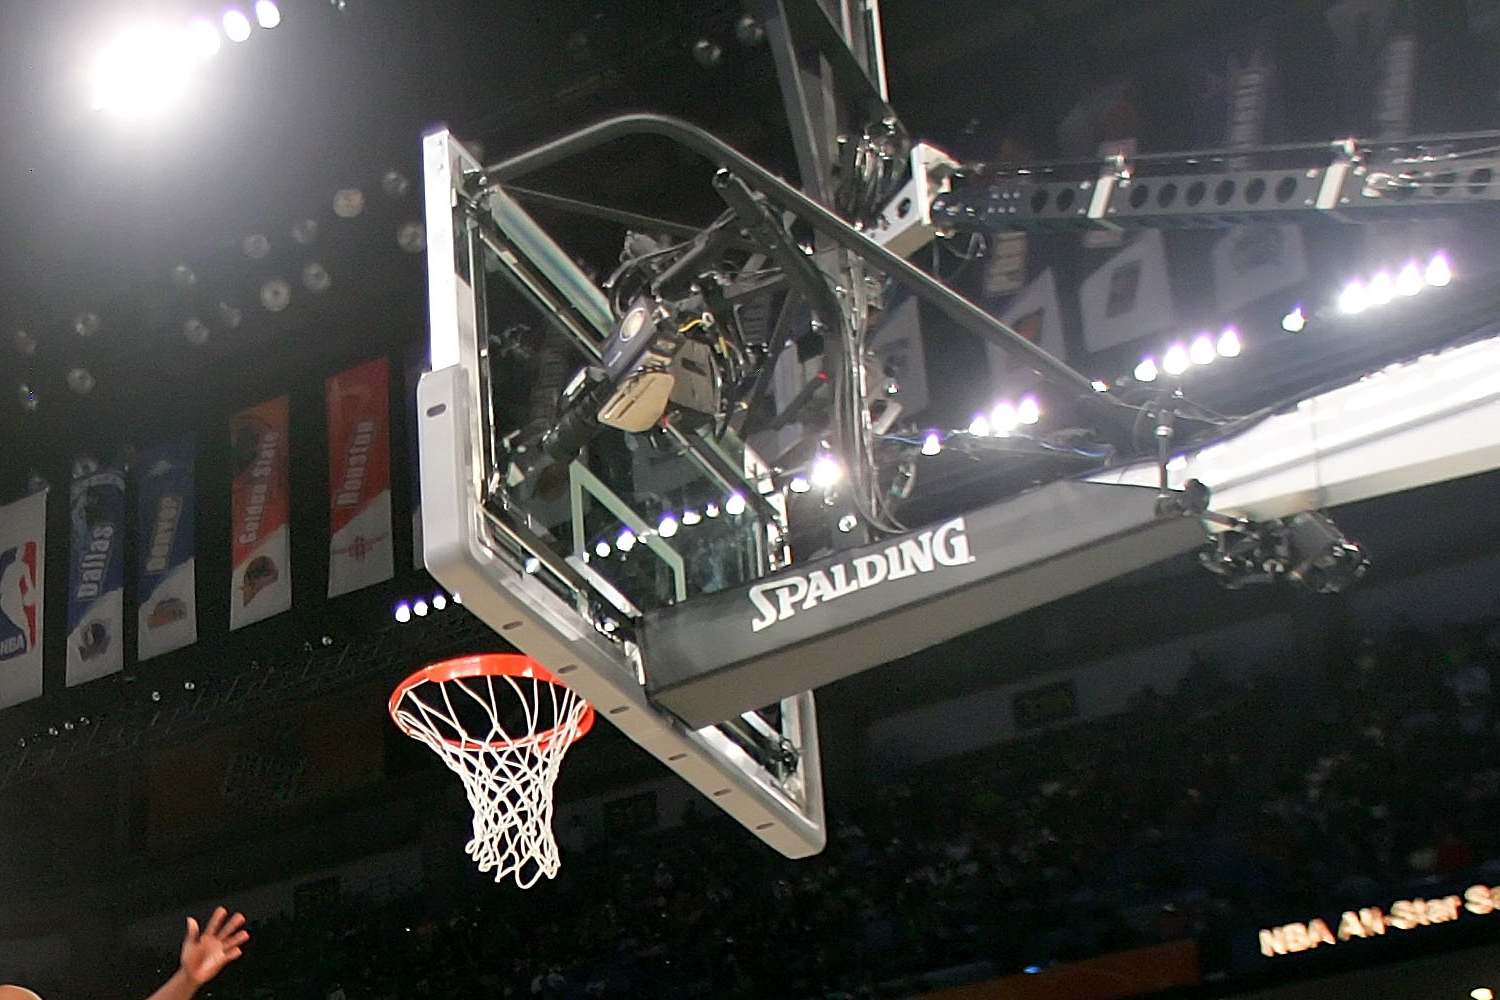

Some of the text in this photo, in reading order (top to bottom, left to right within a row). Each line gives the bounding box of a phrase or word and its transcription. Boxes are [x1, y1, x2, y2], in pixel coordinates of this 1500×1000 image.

[77, 525, 114, 599] Dallas
[749, 517, 976, 632] SPALDING
[1259, 917, 1336, 957] NBA
